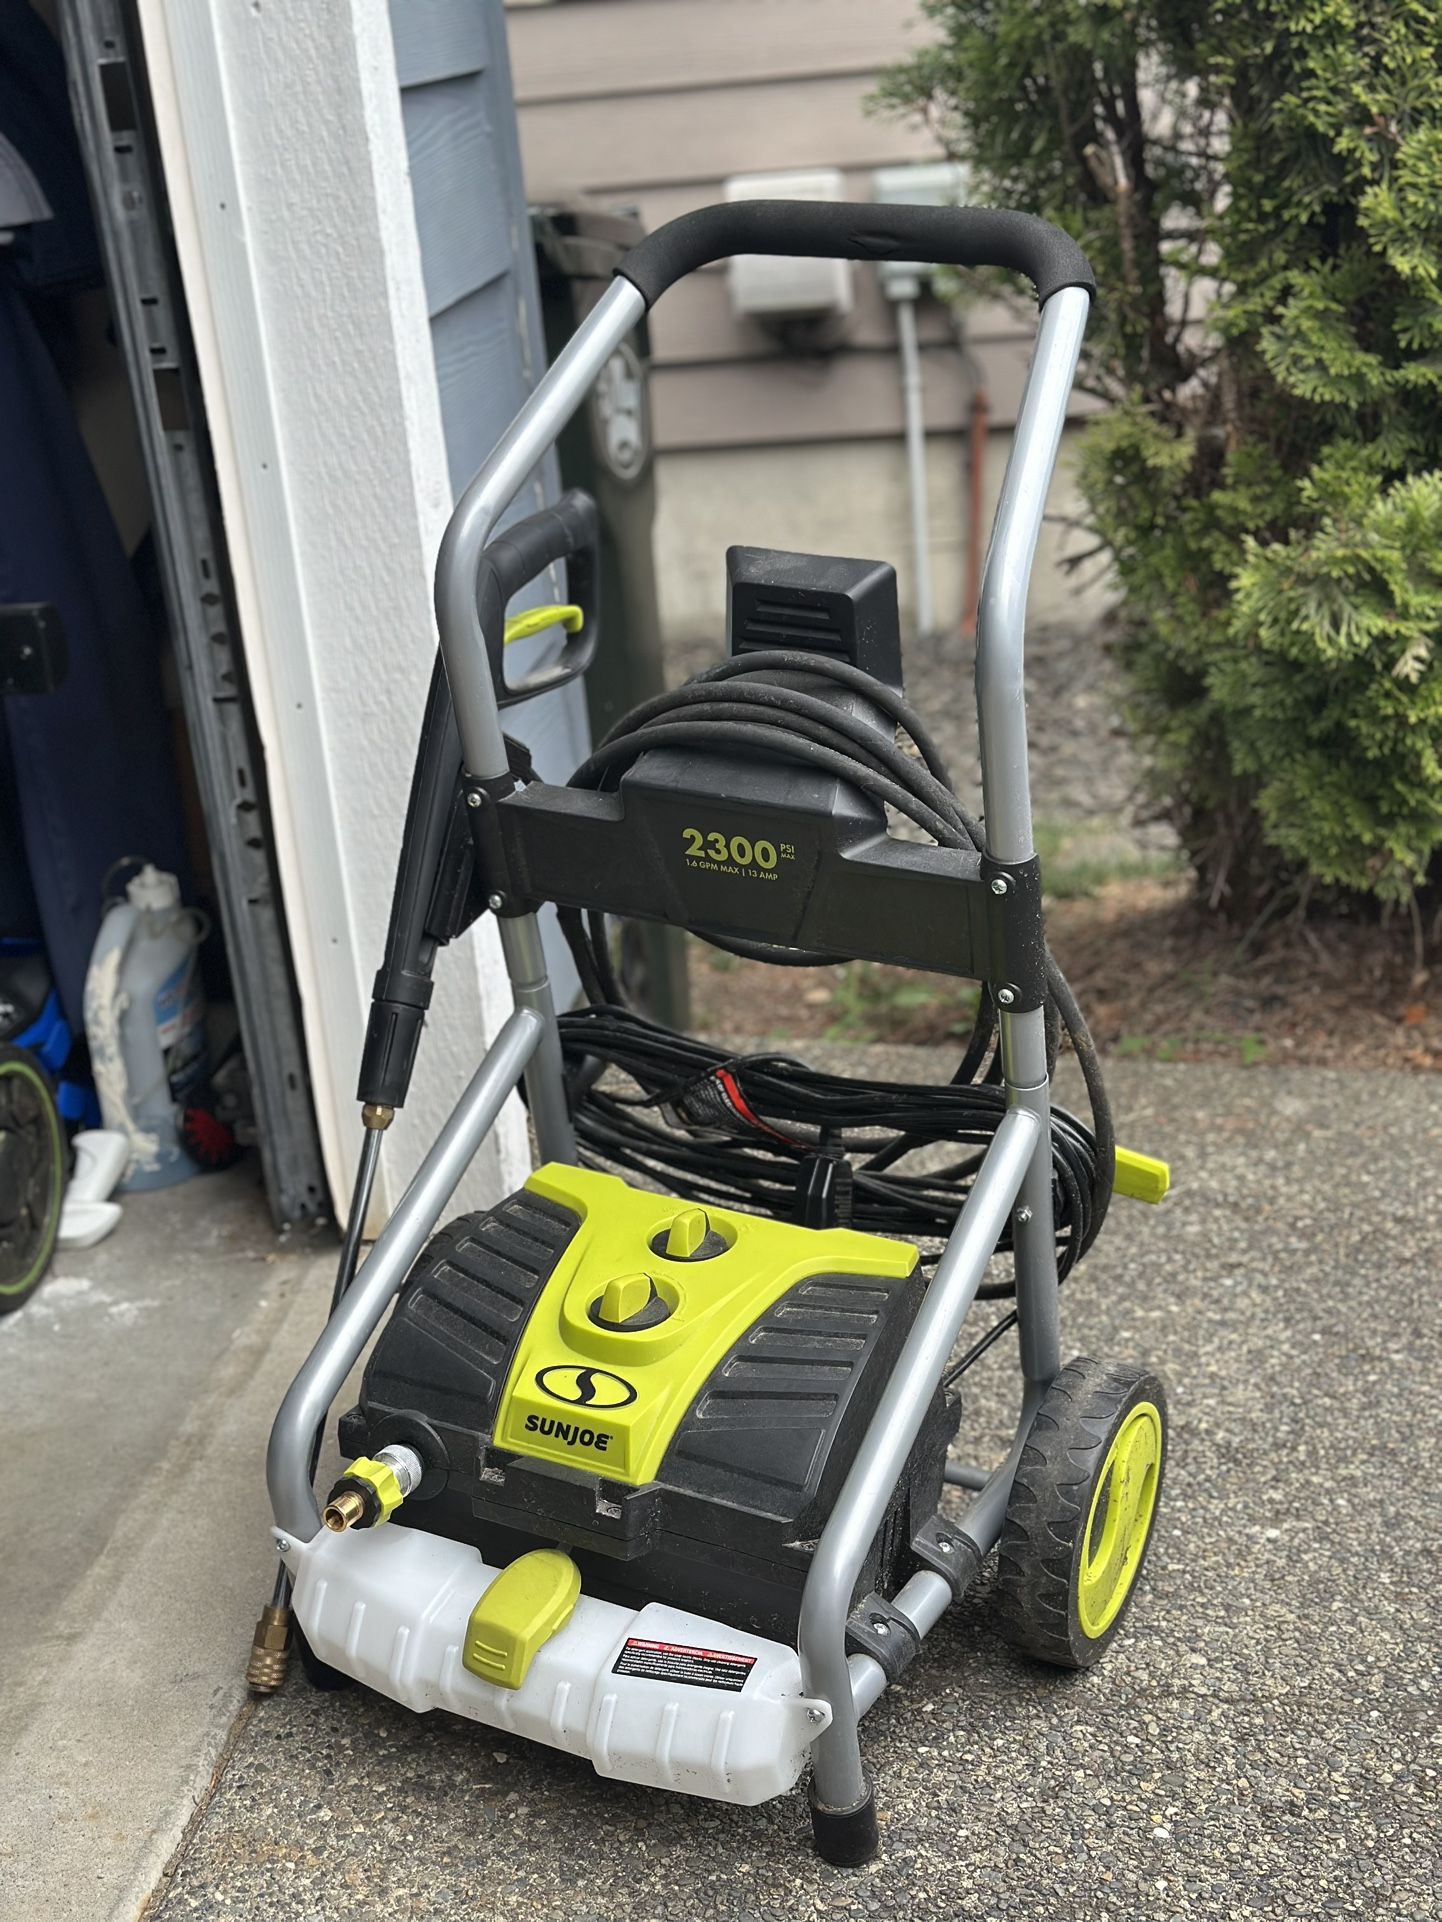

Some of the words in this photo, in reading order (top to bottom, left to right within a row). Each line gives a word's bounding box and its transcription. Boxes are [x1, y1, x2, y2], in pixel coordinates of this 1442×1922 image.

[682, 827, 778, 870] 2300
[780, 843, 795, 854] PSI
[686, 858, 698, 868] 1.6
[699, 861, 719, 871] GPM
[720, 864, 740, 875] MAX
[748, 869, 758, 878] 13
[759, 872, 778, 881] AMP
[524, 1414, 611, 1452] SUNJOE
